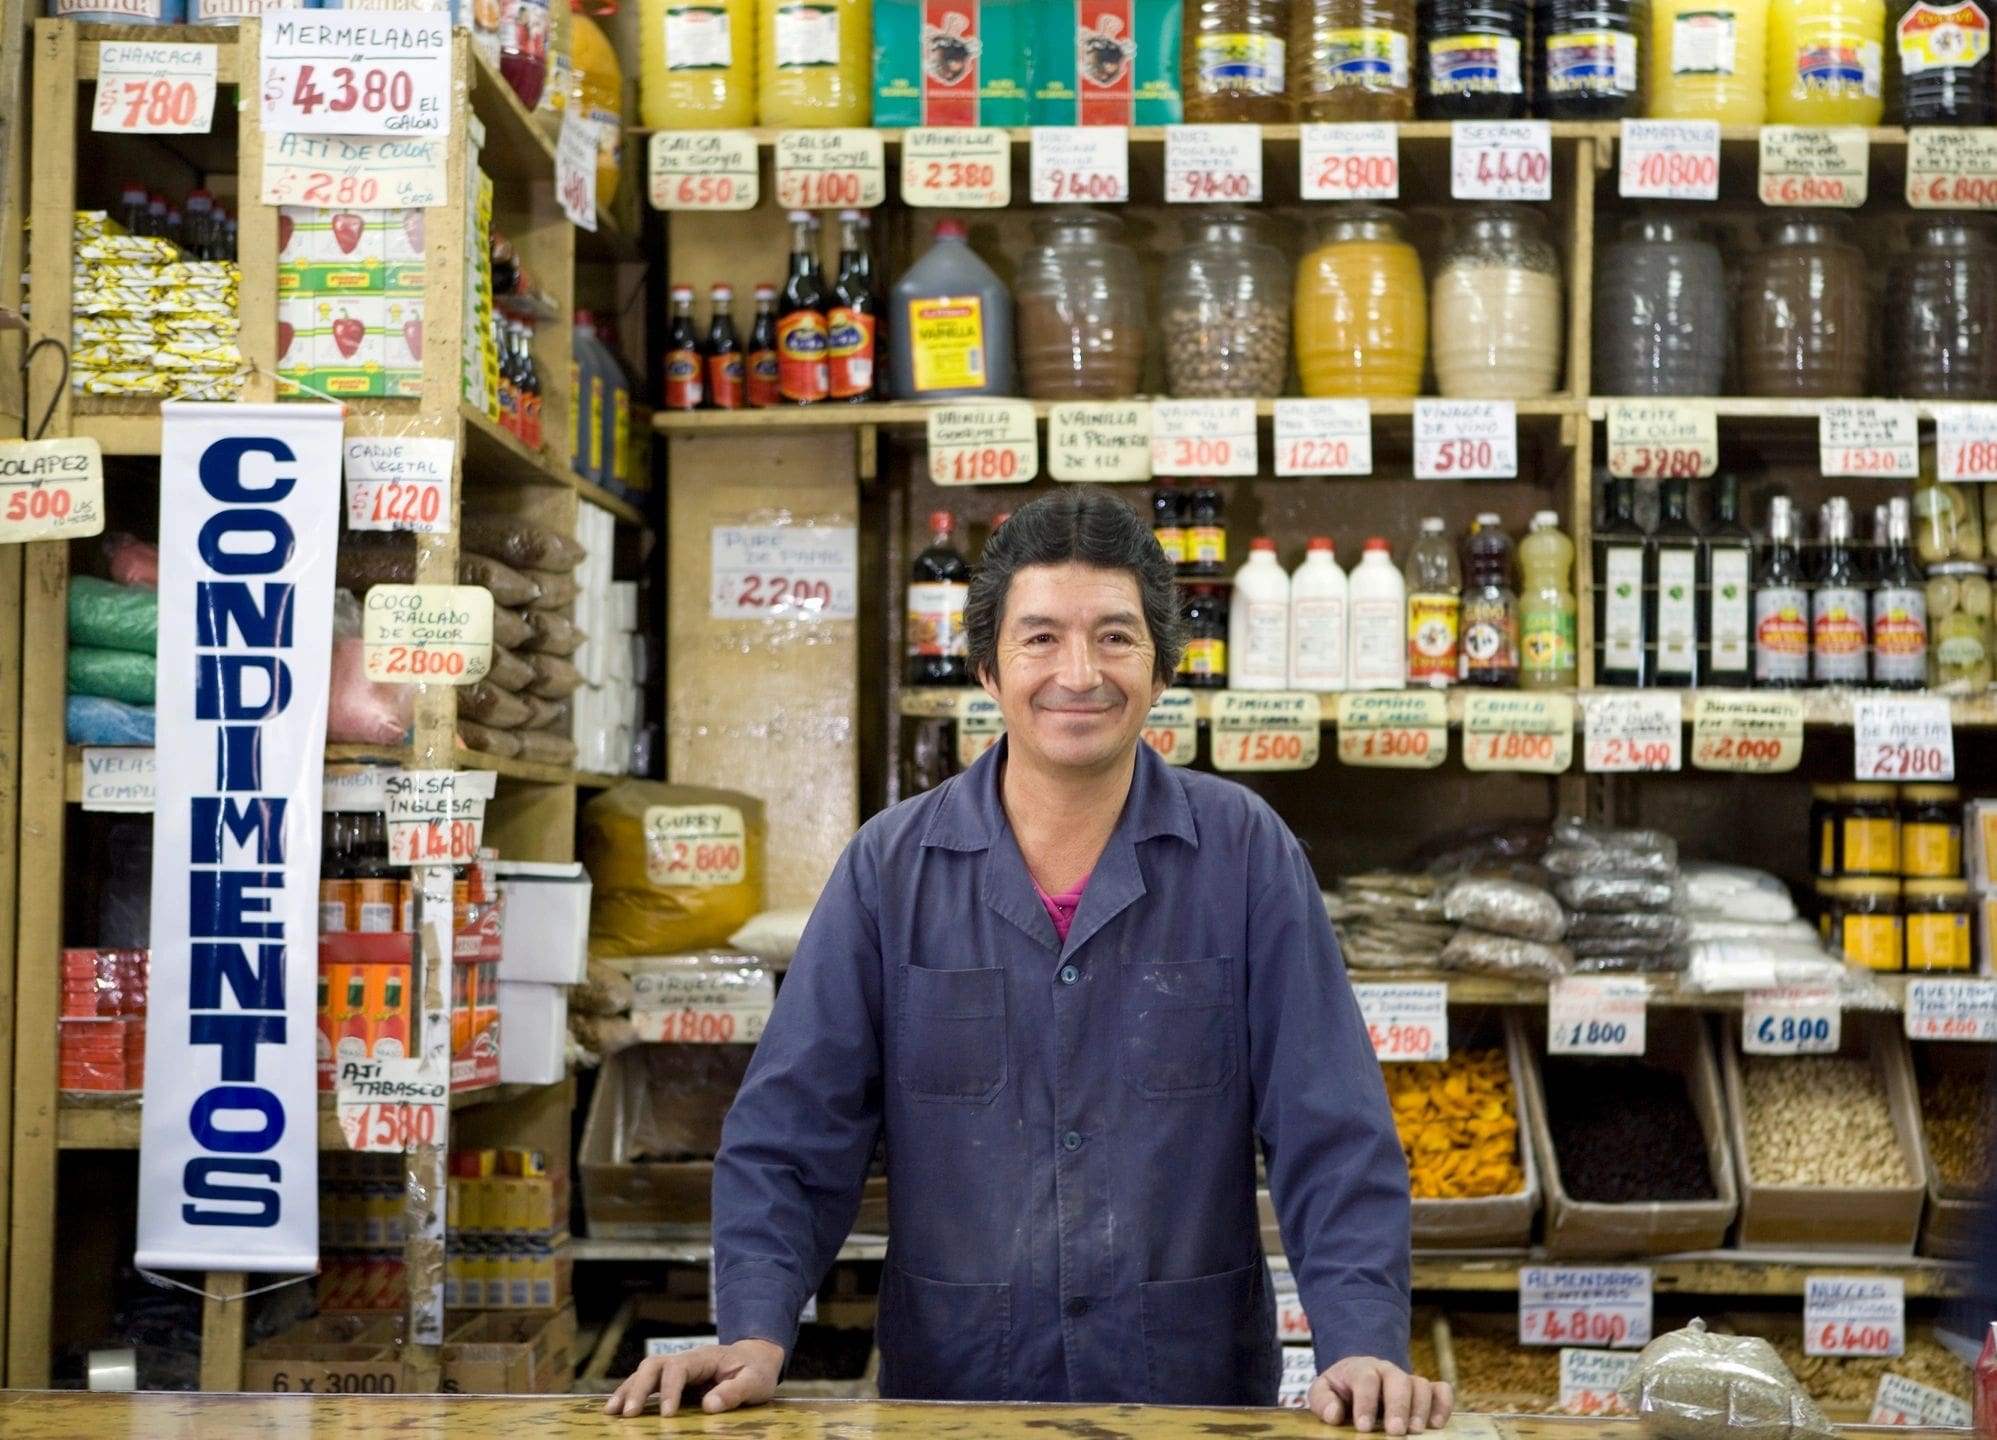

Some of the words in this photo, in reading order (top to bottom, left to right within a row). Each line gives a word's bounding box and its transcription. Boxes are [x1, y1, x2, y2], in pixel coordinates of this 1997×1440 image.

[276, 22, 444, 49] MERMELADAS
[103, 48, 203, 64] CHANCACA
[122, 80, 197, 128] 780
[420, 97, 438, 112] EL
[341, 142, 370, 161] DE
[303, 172, 378, 204] 280
[677, 175, 733, 204] 650
[924, 162, 994, 190] 2380
[371, 459, 437, 474] VEGETAL
[953, 447, 1017, 482] 1180
[1173, 438, 1232, 468] 300
[1434, 438, 1492, 472] 580
[6, 488, 72, 521] 500
[371, 482, 441, 523] 1220
[368, 593, 423, 611] COCO
[738, 574, 832, 610] 2200
[379, 627, 403, 639] DE
[412, 627, 462, 639] COLOR
[394, 612, 470, 626] RALLADO
[385, 646, 465, 677] 2800
[1238, 733, 1302, 763] 1500
[1362, 729, 1429, 758] 1300
[1487, 733, 1553, 761] 1800
[88, 757, 156, 775] VELAS
[385, 775, 455, 794] SALSA
[182, 436, 298, 1229] CONDIMENTOS
[661, 1011, 734, 1043] 1800
[1758, 1016, 1830, 1044] 6800
[352, 1081, 444, 1098] TABASCO
[1542, 1309, 1627, 1341] 4800
[273, 1372, 290, 1394] 6
[326, 1372, 397, 1394] 3000
